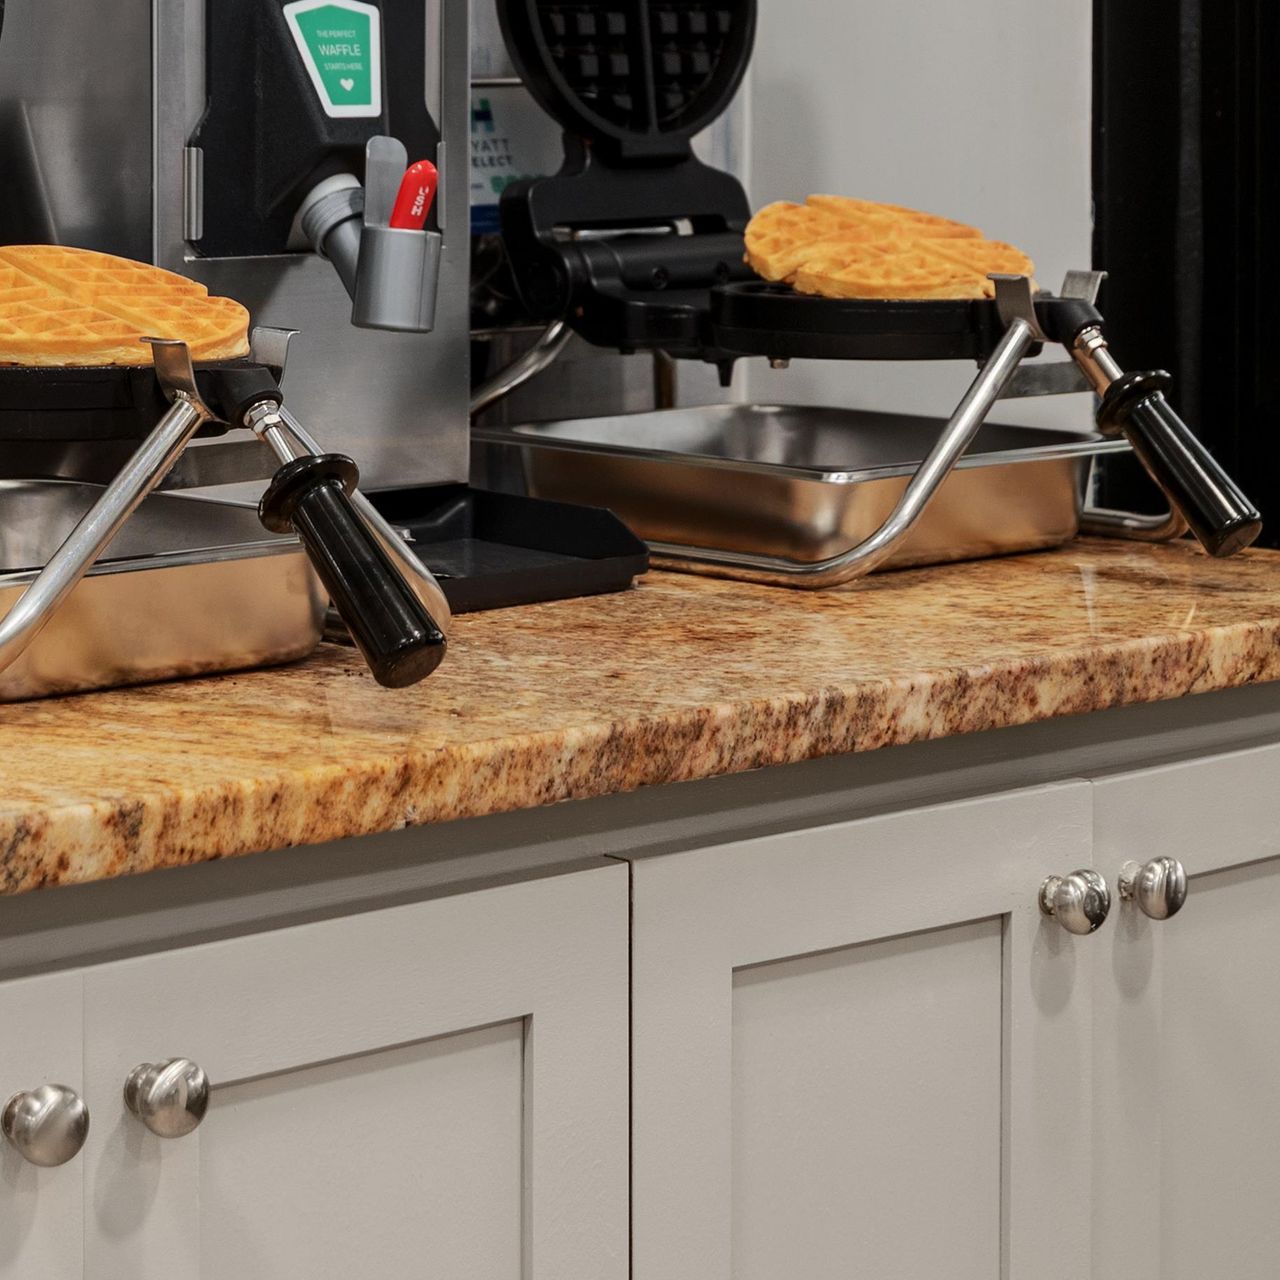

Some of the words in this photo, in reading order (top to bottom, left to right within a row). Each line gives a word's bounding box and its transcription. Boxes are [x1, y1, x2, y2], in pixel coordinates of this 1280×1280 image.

[318, 43, 362, 57] WAFFLE
[471, 139, 510, 153] YATT
[471, 155, 513, 168] ELECT
